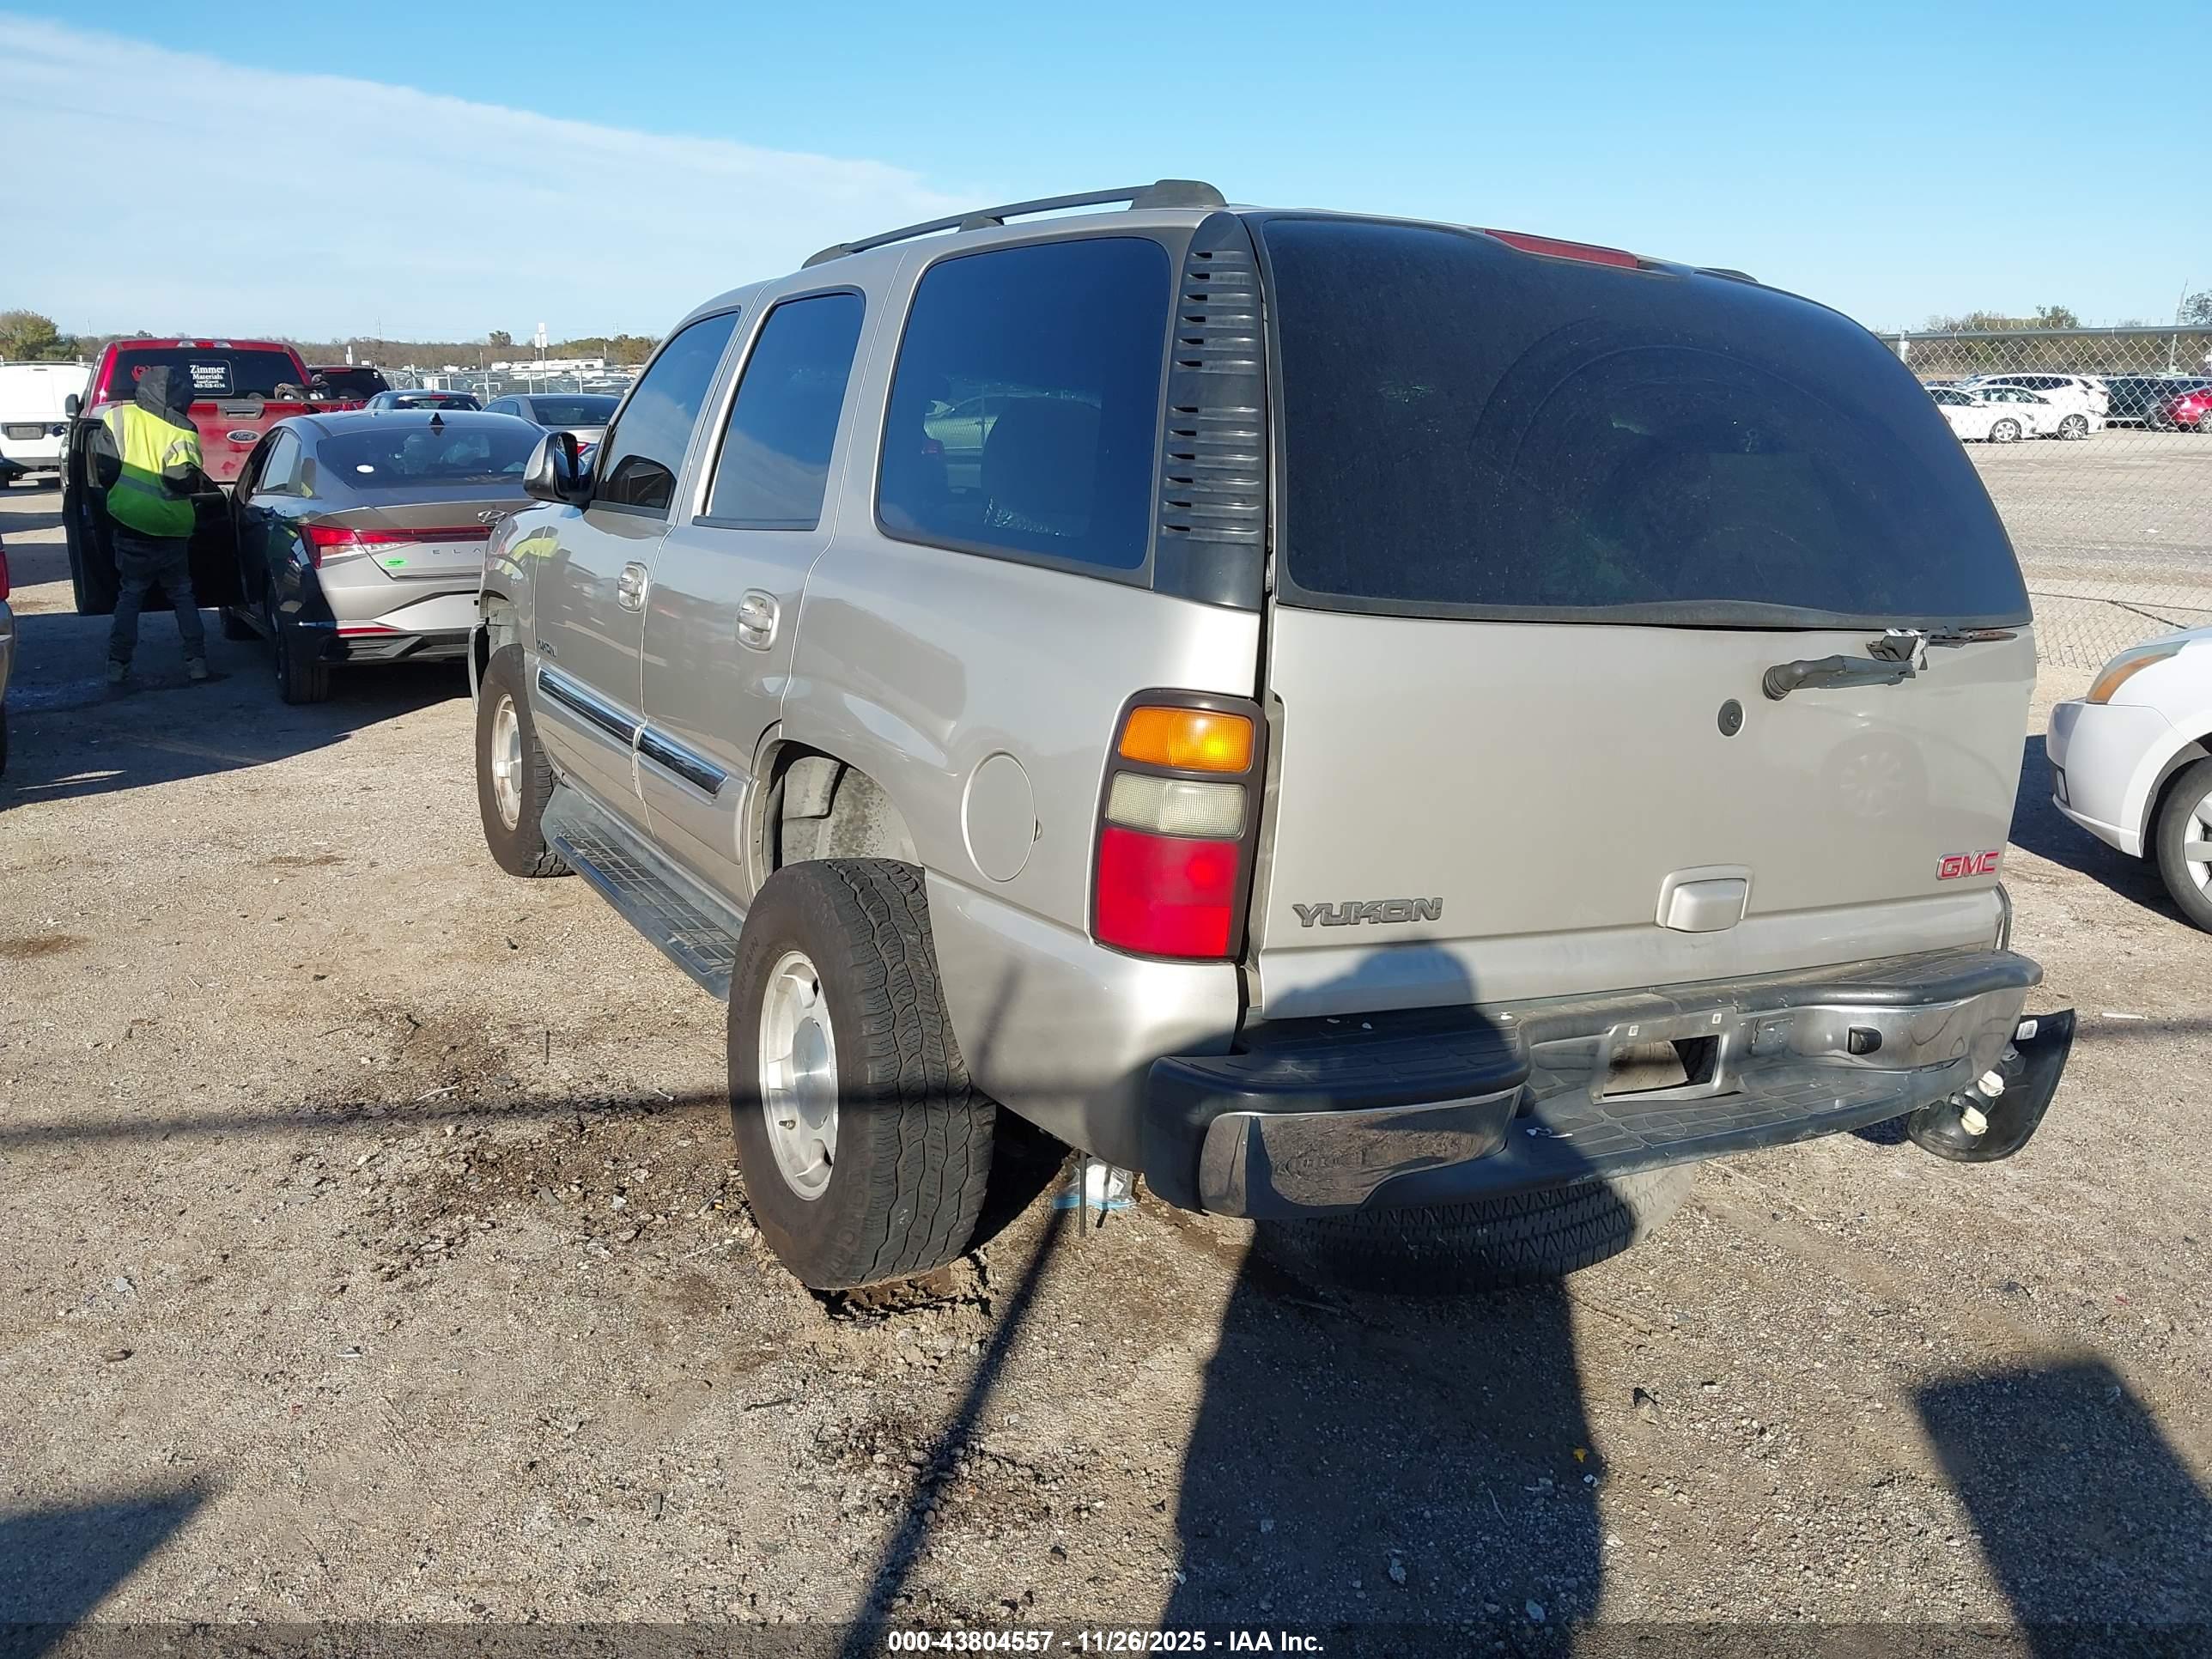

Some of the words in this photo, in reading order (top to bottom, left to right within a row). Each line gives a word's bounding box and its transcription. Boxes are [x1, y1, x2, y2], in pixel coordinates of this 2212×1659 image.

[189, 364, 226, 374] Zimmer
[1936, 851, 1999, 880] GMC
[1292, 896, 1443, 927] YUKON
